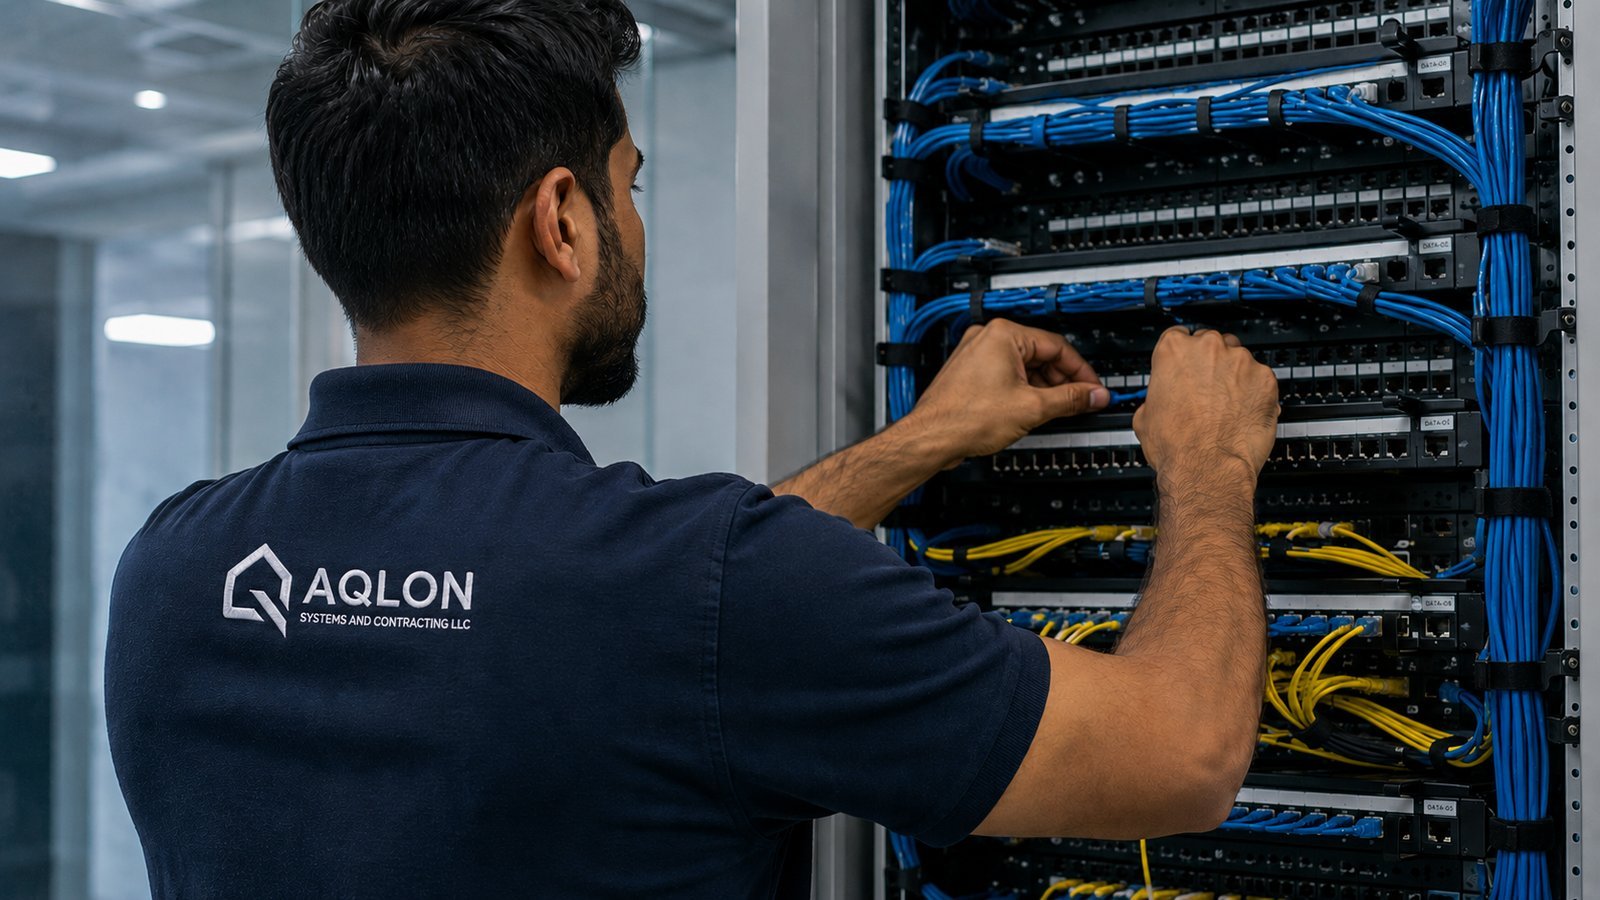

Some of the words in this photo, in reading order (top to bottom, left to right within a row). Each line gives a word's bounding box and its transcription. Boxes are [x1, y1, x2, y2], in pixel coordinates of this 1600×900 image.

[302, 567, 474, 610] AQLON
[300, 612, 347, 624] SYSTEMS
[348, 614, 371, 626] AND
[373, 615, 449, 629] CONTRACTING
[451, 618, 471, 630] LLC
